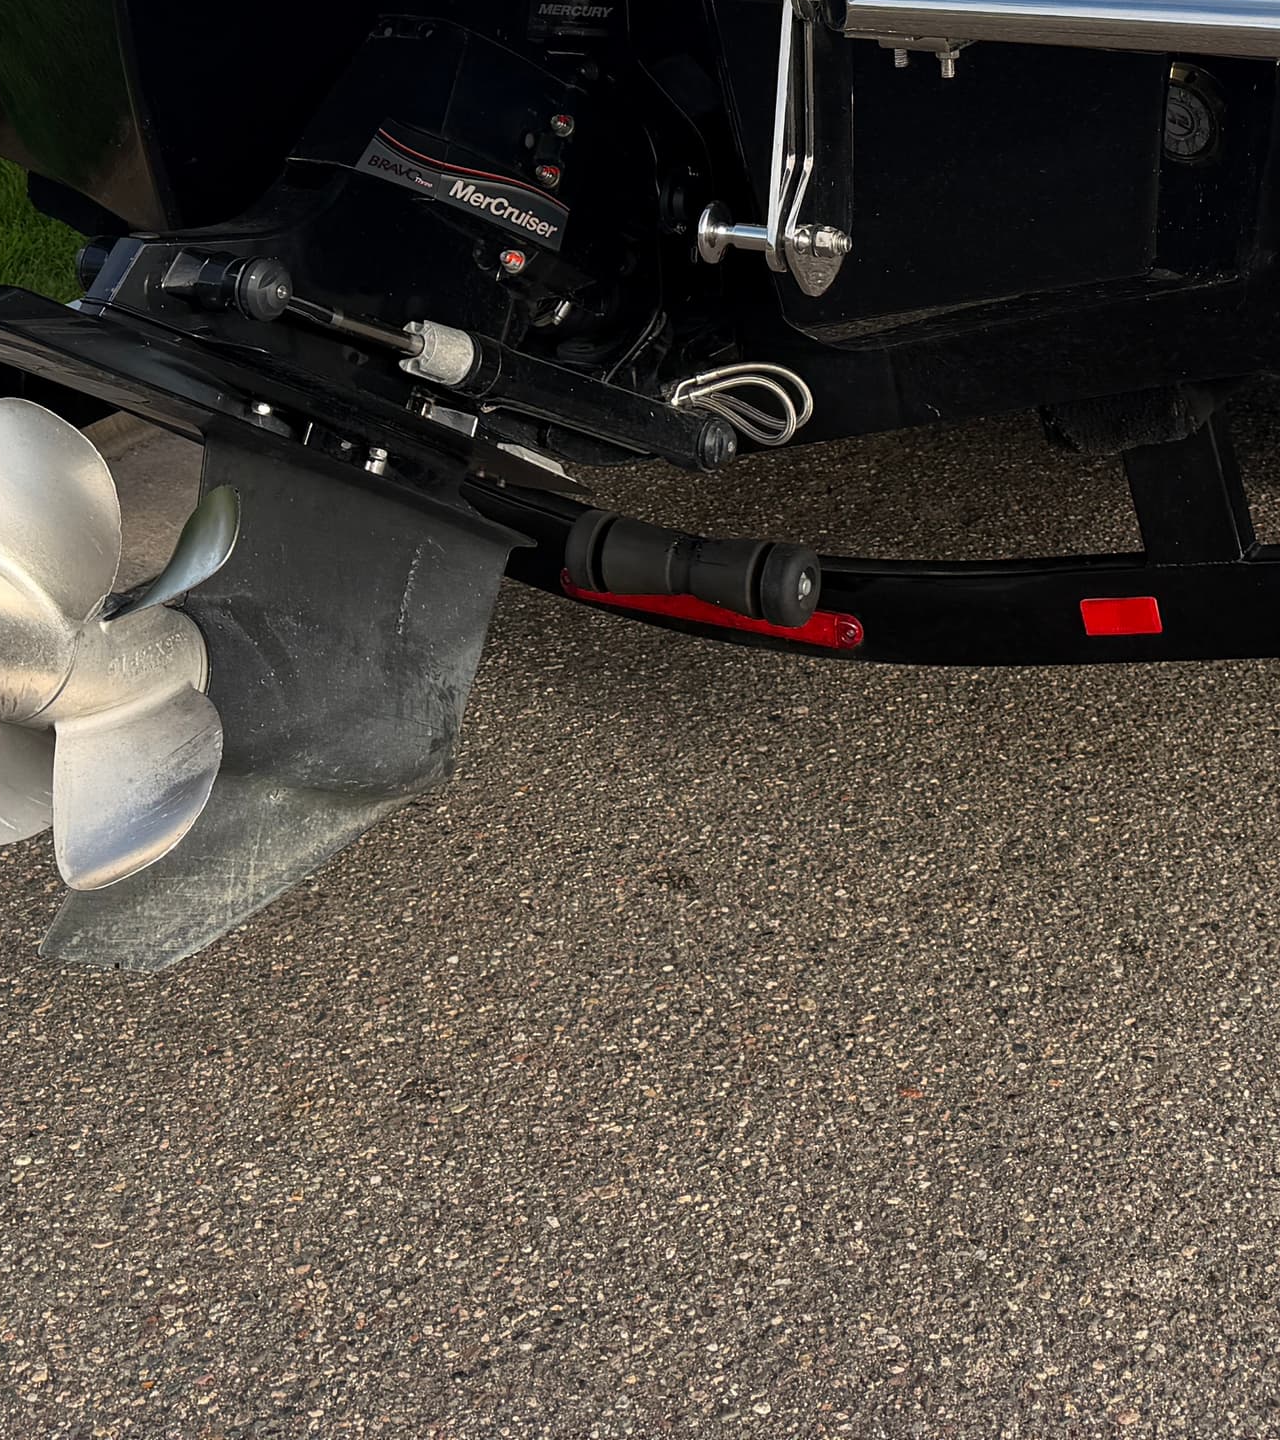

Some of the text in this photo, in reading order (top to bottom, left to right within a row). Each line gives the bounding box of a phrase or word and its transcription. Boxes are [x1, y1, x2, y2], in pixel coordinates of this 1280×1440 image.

[538, 3, 613, 18] MERCURY
[367, 154, 422, 182] BRAVO
[448, 179, 558, 238] MerCruiser
